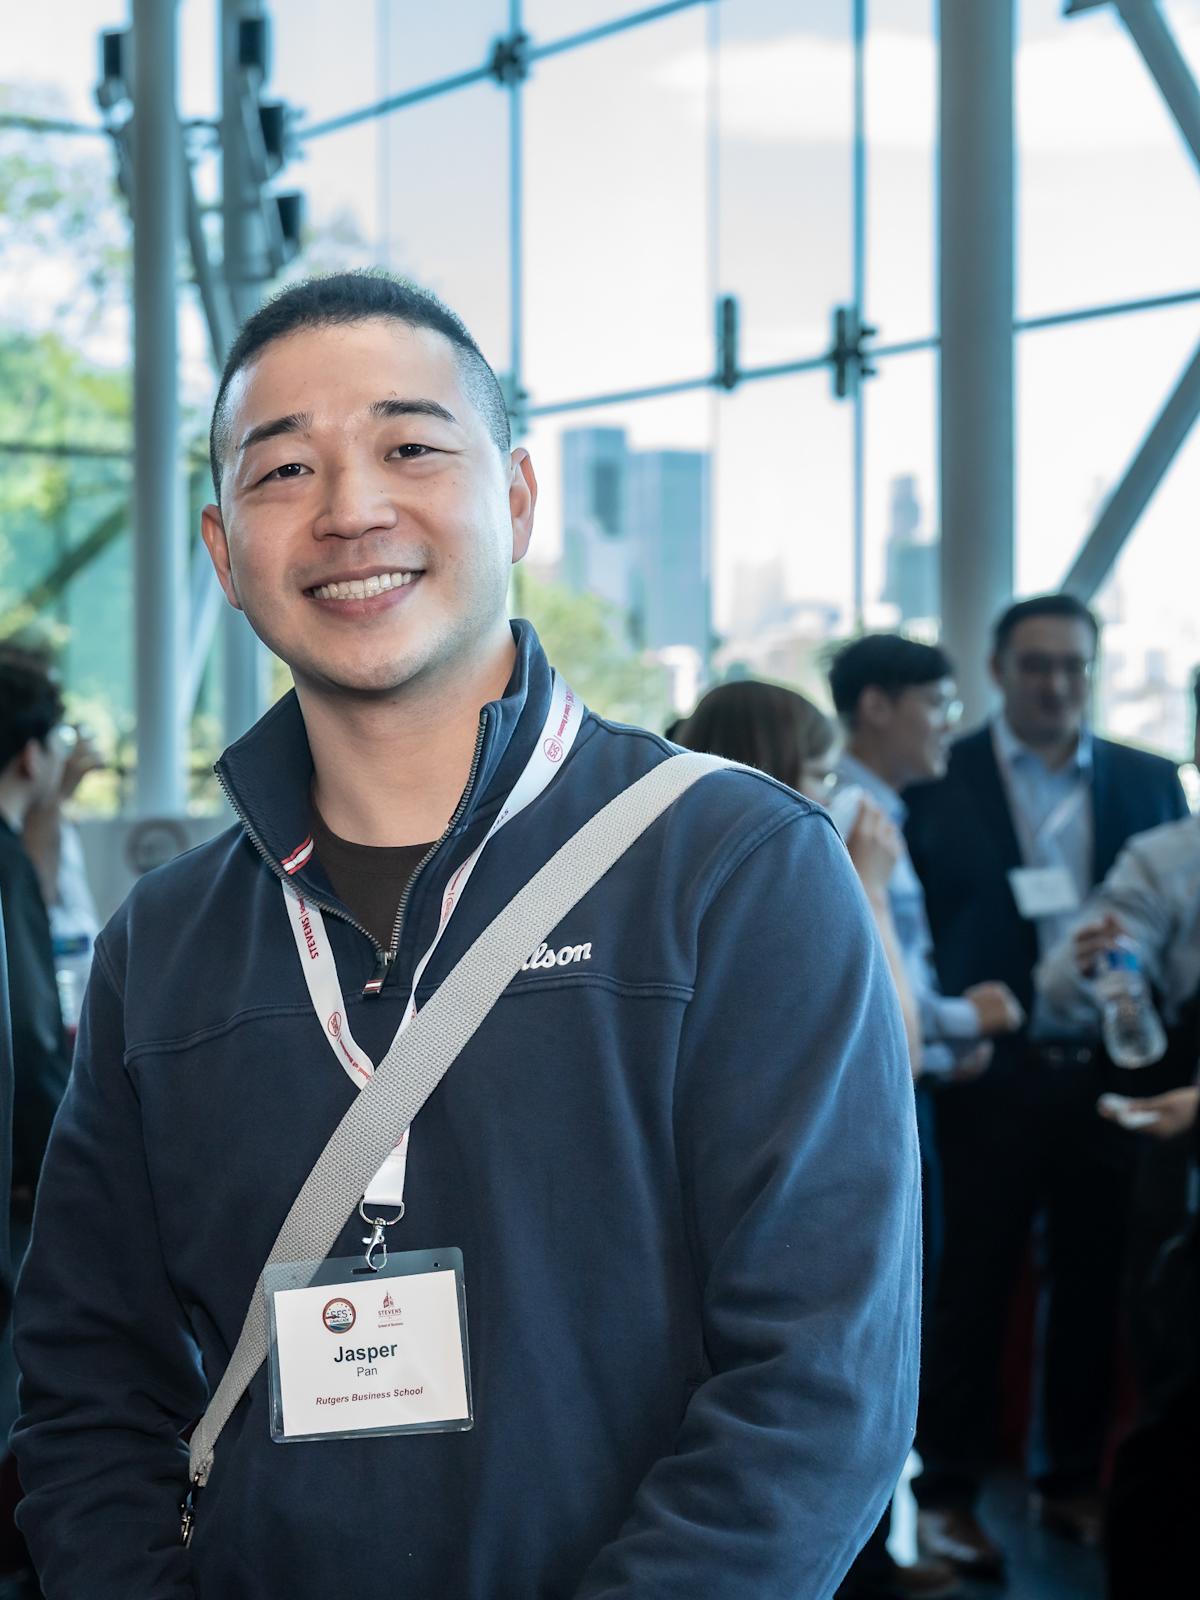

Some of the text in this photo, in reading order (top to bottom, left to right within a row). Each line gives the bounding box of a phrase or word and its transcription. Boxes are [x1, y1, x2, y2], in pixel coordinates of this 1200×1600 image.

[302, 917, 319, 960] STEVENS
[521, 942, 592, 971] lson
[378, 1308, 402, 1316] STEVENS
[333, 1343, 398, 1363] Jasper
[357, 1367, 378, 1377] Pan
[315, 1386, 424, 1406] Rutgers Business School
